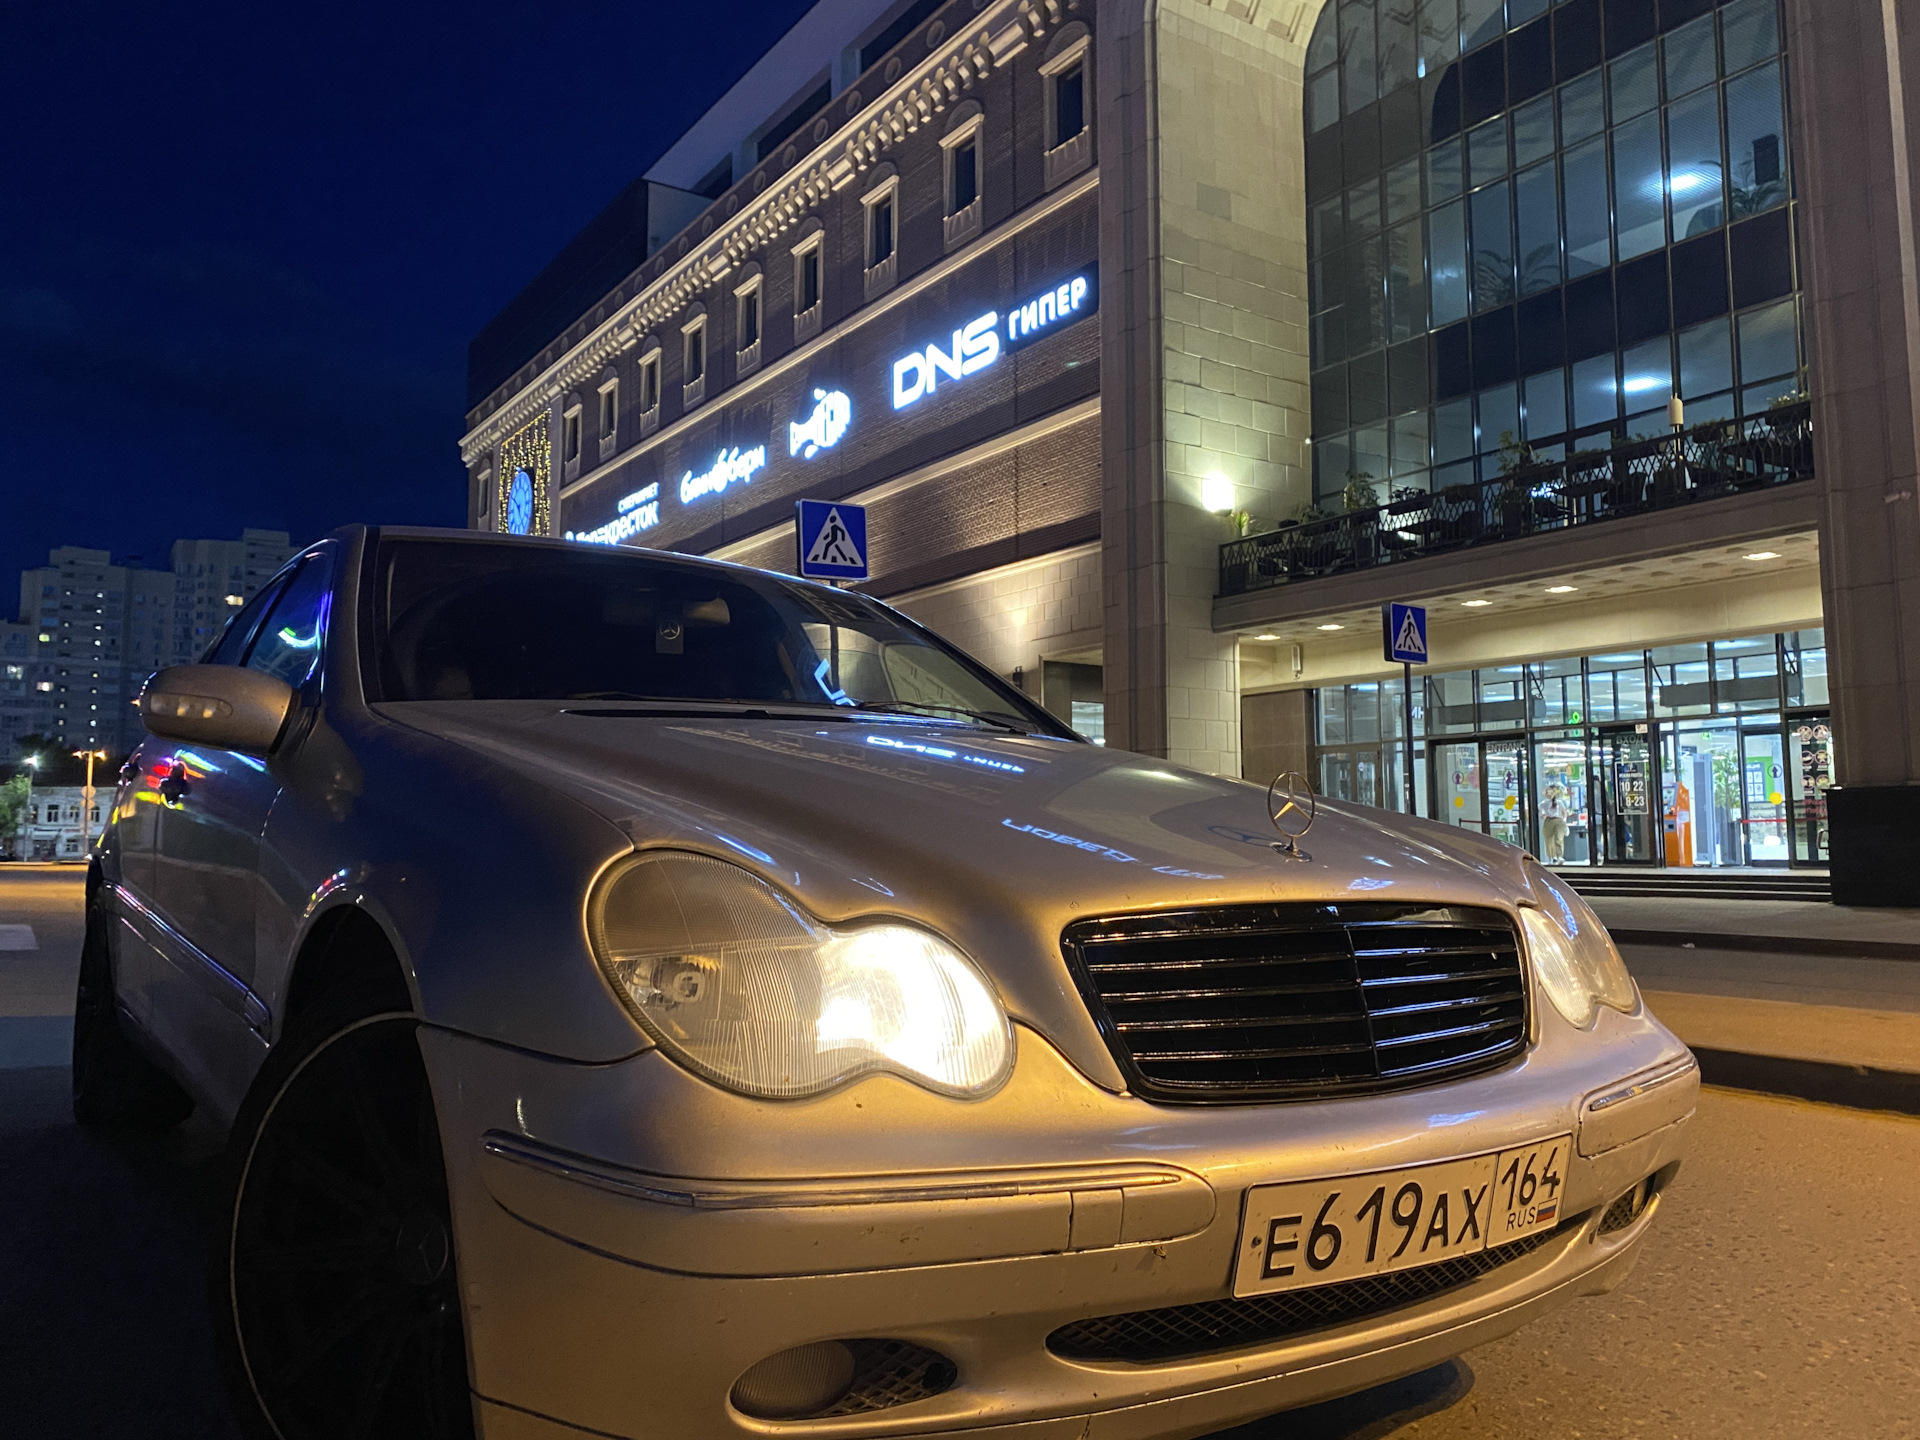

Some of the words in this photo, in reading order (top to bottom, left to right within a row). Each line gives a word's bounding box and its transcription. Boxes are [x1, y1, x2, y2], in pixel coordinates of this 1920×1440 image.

[1008, 276, 1087, 341] ГИПЕР
[893, 310, 1000, 410] DNS
[1485, 741, 1526, 753] ENTRANC
[1616, 735, 1644, 745] ВХОД
[1625, 795, 1645, 807] 8-23
[1502, 1147, 1561, 1211] 164
[1262, 1182, 1489, 1280] Е619АХ
[1506, 1205, 1536, 1232] RUS
